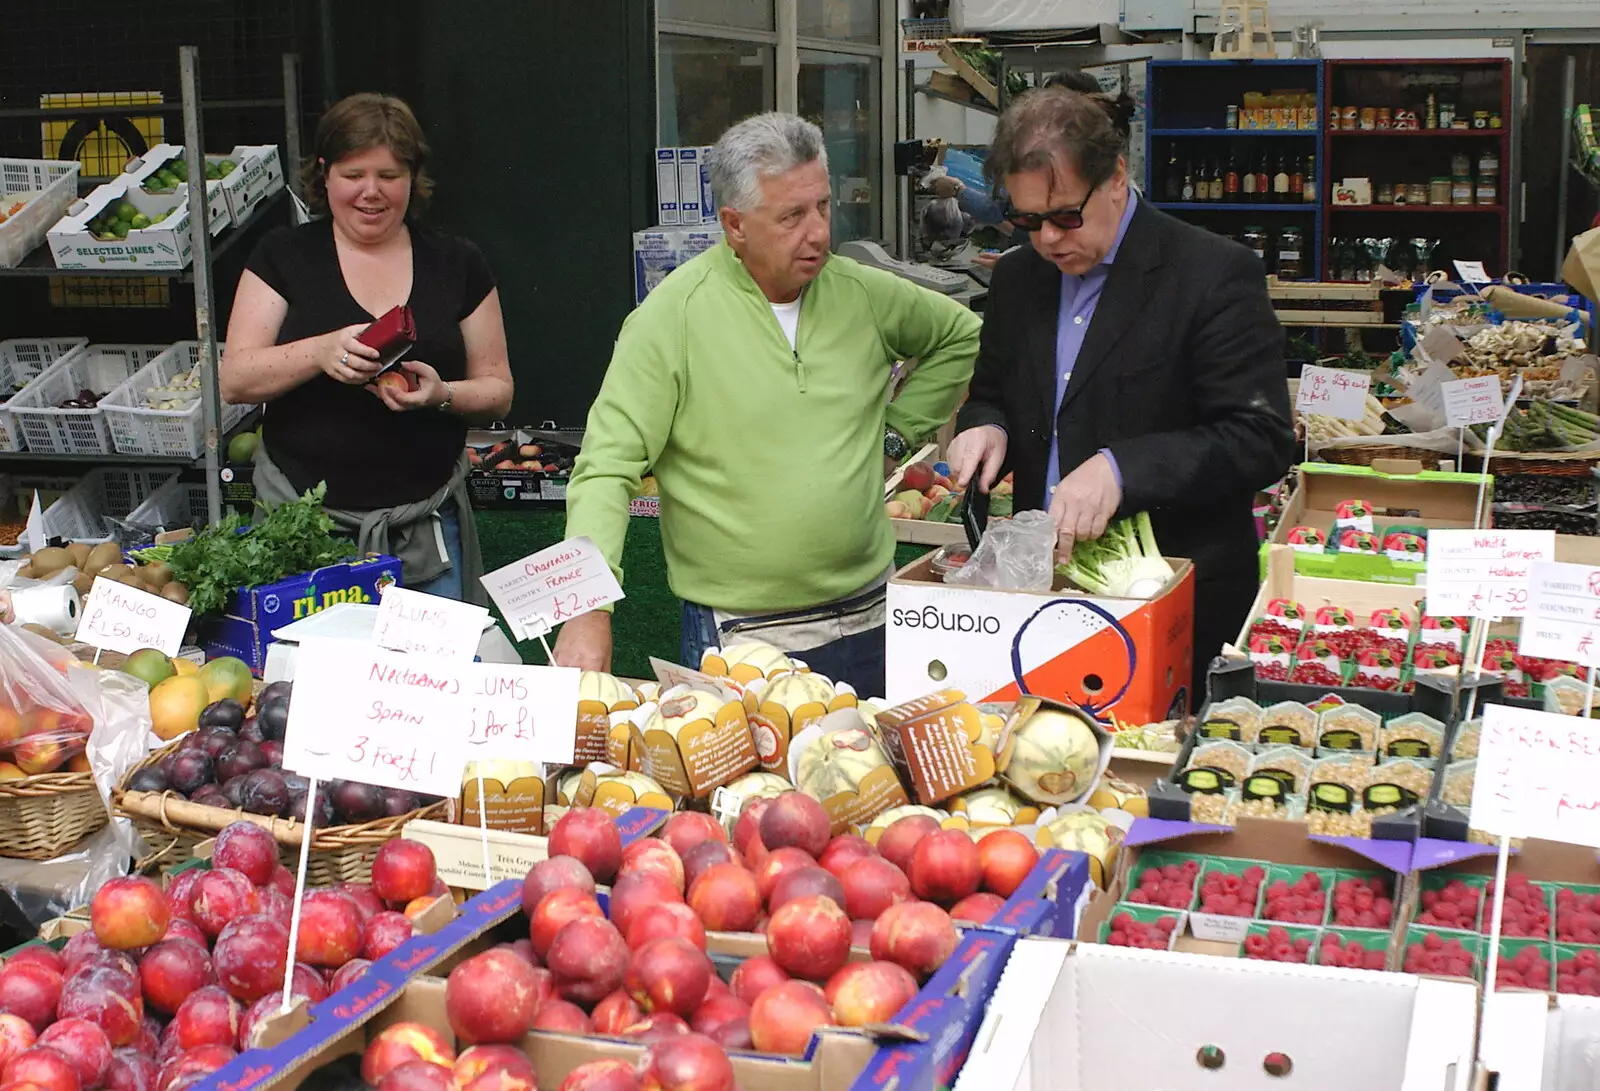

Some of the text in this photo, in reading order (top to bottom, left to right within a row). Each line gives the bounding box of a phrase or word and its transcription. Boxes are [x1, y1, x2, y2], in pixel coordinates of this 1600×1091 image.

[76, 247, 125, 256] SELECTED
[126, 245, 155, 255] LIMES
[545, 567, 583, 589] FRANCE
[1542, 580, 1583, 592] VARIETY
[95, 586, 157, 619] MANGO
[387, 592, 447, 629] PLUMS
[553, 592, 583, 620] £2
[1538, 603, 1585, 615] COUNTRY
[892, 605, 1000, 634] oranges
[1536, 631, 1561, 640] PRICE
[346, 735, 369, 763] 3
[496, 854, 515, 864] Très
